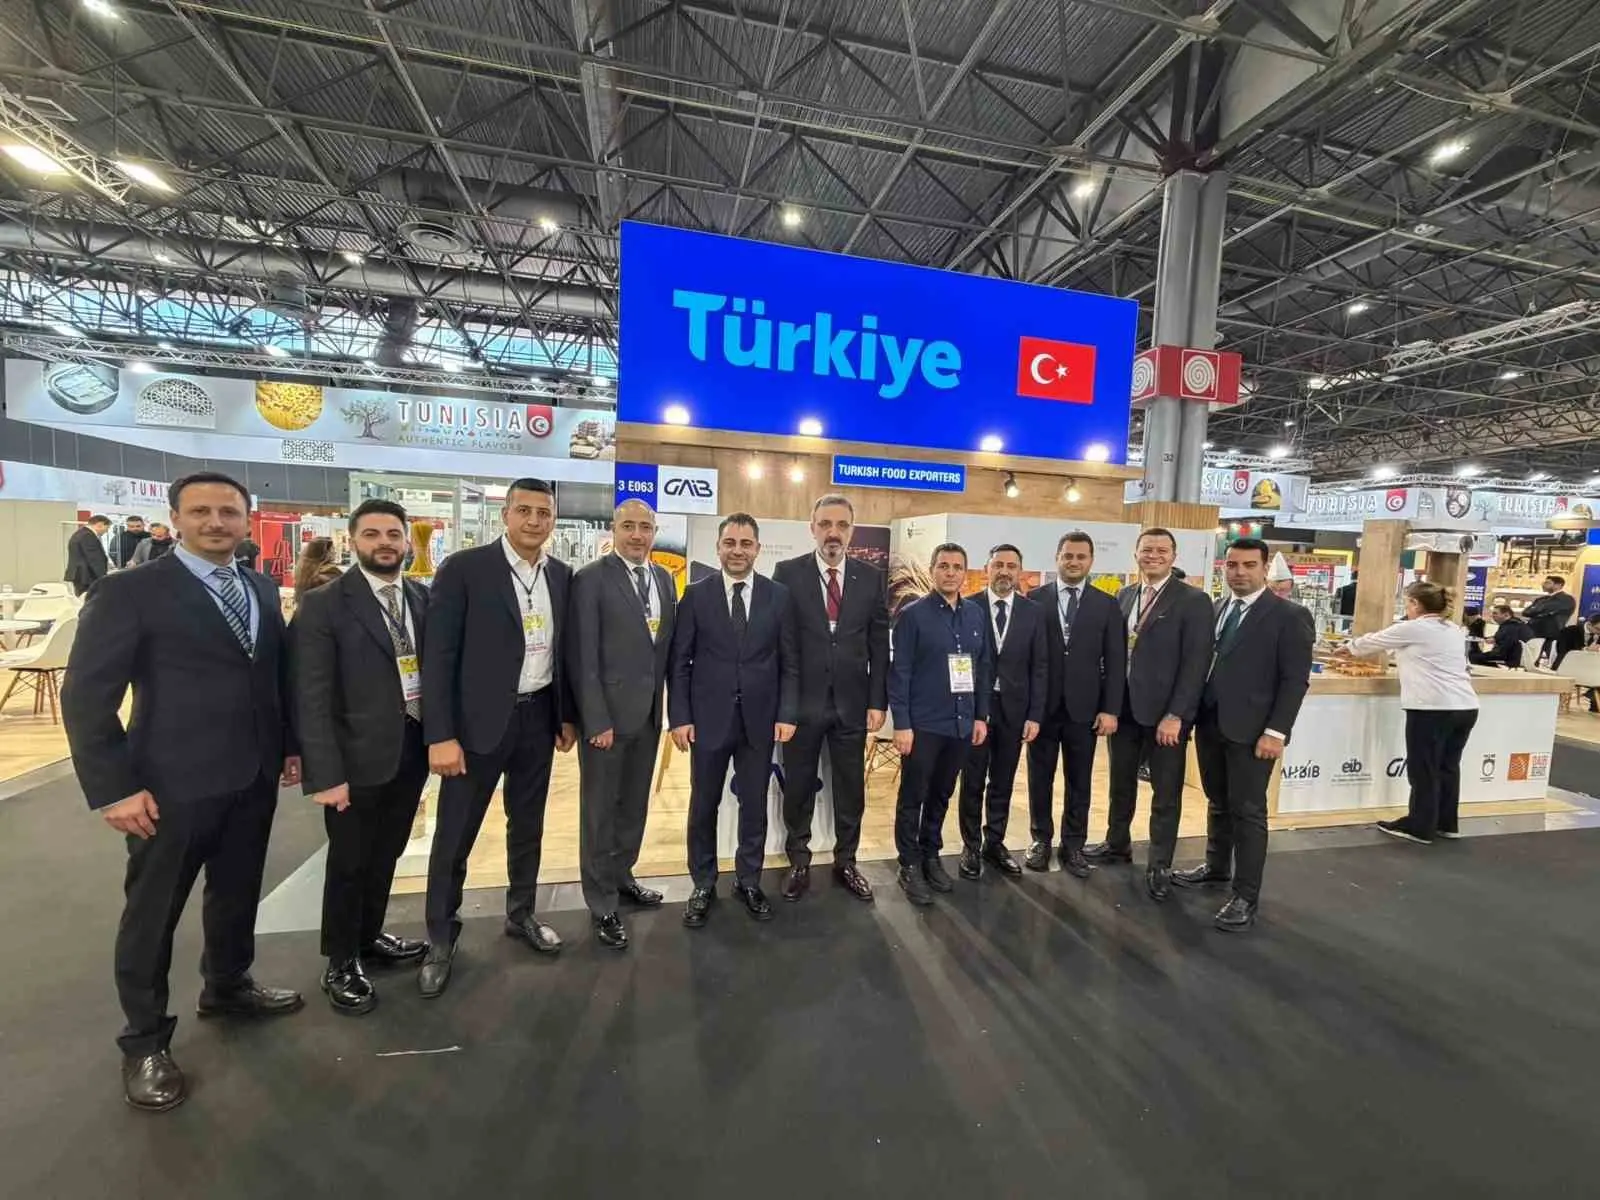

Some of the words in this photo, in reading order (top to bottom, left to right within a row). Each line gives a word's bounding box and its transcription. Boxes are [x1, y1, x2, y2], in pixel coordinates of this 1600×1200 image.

[673, 289, 962, 399] Türkiye
[398, 401, 521, 430] TUNISIA
[399, 434, 466, 448] AUTHENTIC
[471, 440, 523, 451] FLAVORS
[838, 464, 880, 477] TURKISH
[881, 467, 907, 480] FOOD
[909, 469, 961, 484] EXPORTERS
[130, 480, 170, 498] TUNI
[618, 479, 625, 491] 3
[628, 480, 654, 493] E063
